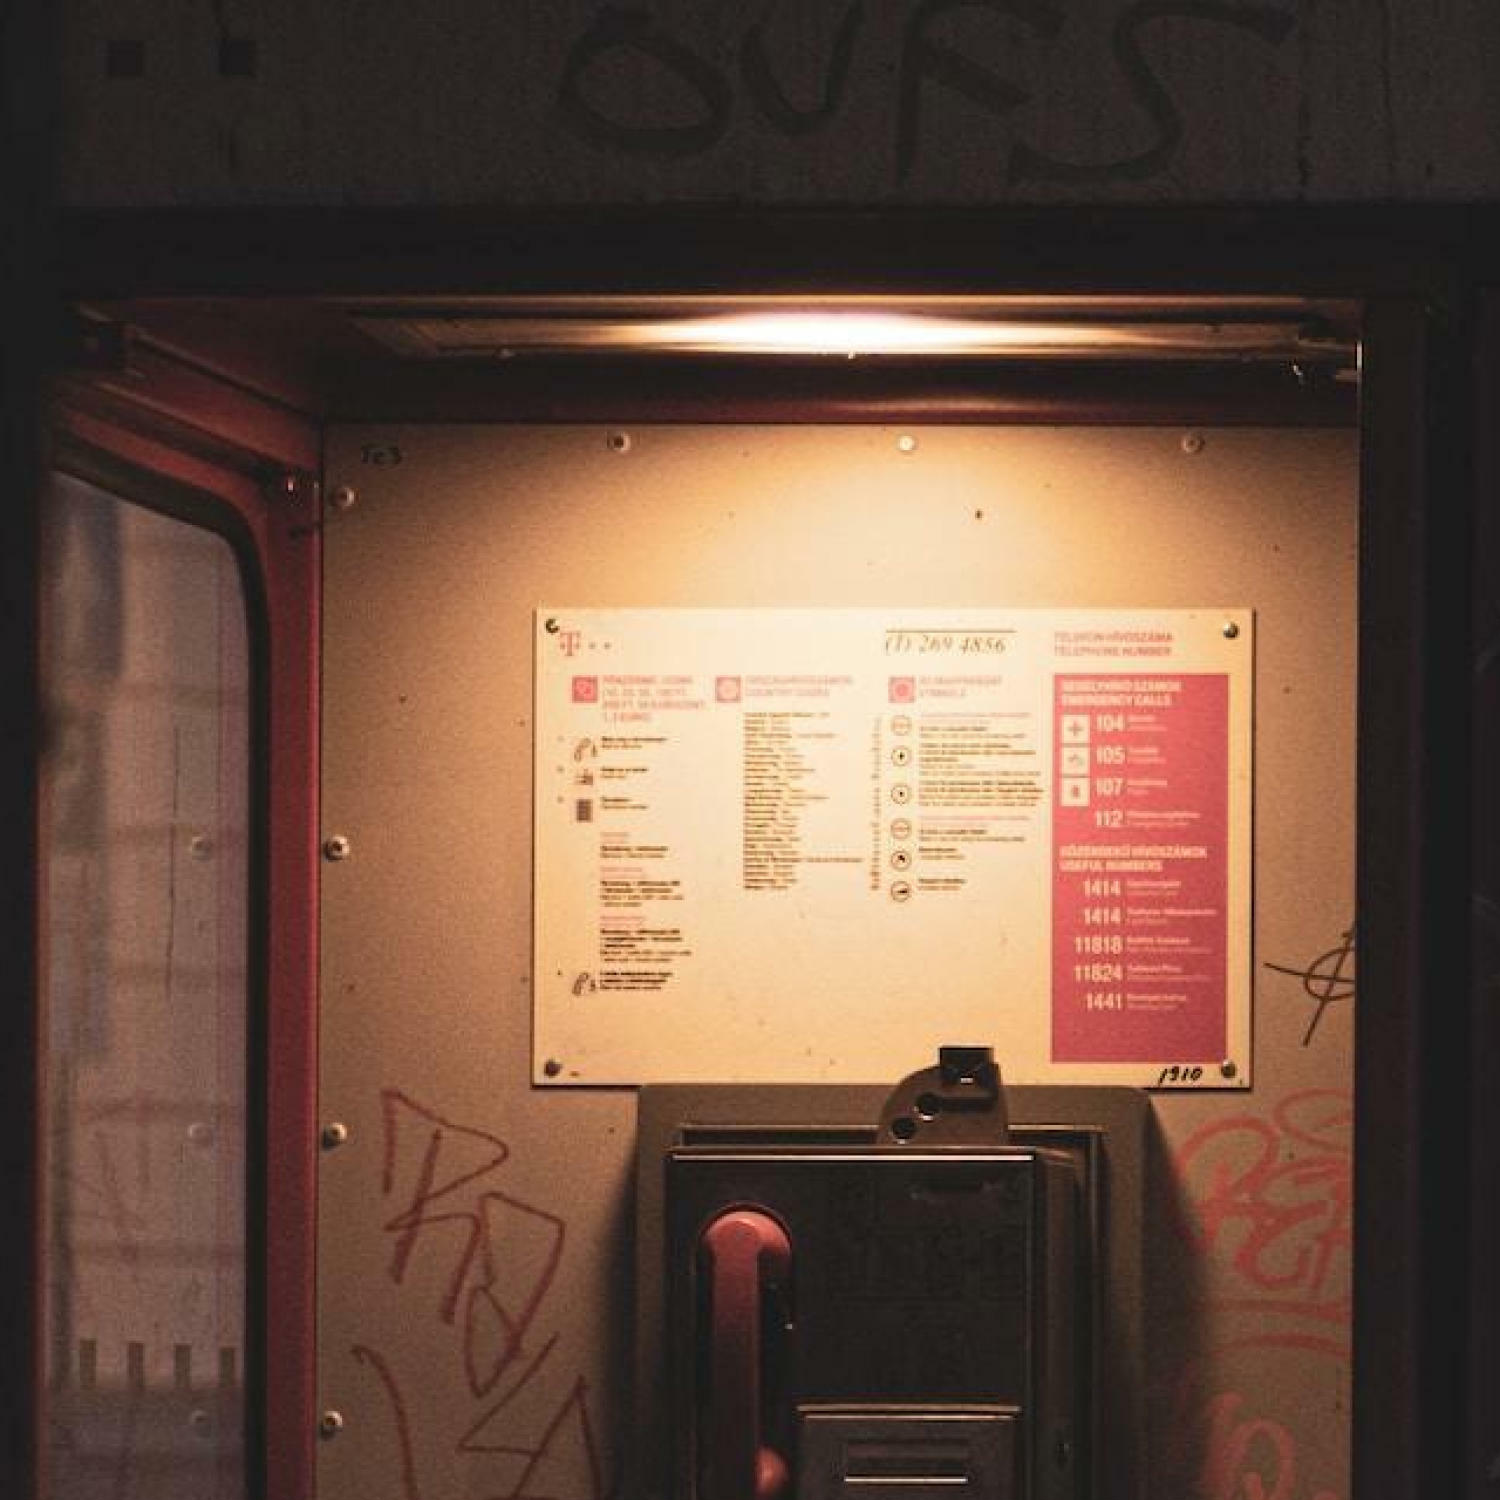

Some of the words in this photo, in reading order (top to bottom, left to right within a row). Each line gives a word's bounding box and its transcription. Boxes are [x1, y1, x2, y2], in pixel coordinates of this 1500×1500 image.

[1096, 715, 1124, 732] 104
[1096, 747, 1125, 764] 105
[1096, 779, 1123, 796] 107
[1095, 810, 1124, 828] 112
[1084, 880, 1121, 896] 1414
[1084, 908, 1121, 924] 1414
[1075, 936, 1122, 953] 11818
[1075, 964, 1122, 982] 11824
[1087, 993, 1121, 1009] 1441
[1158, 1066, 1203, 1087] 1910
